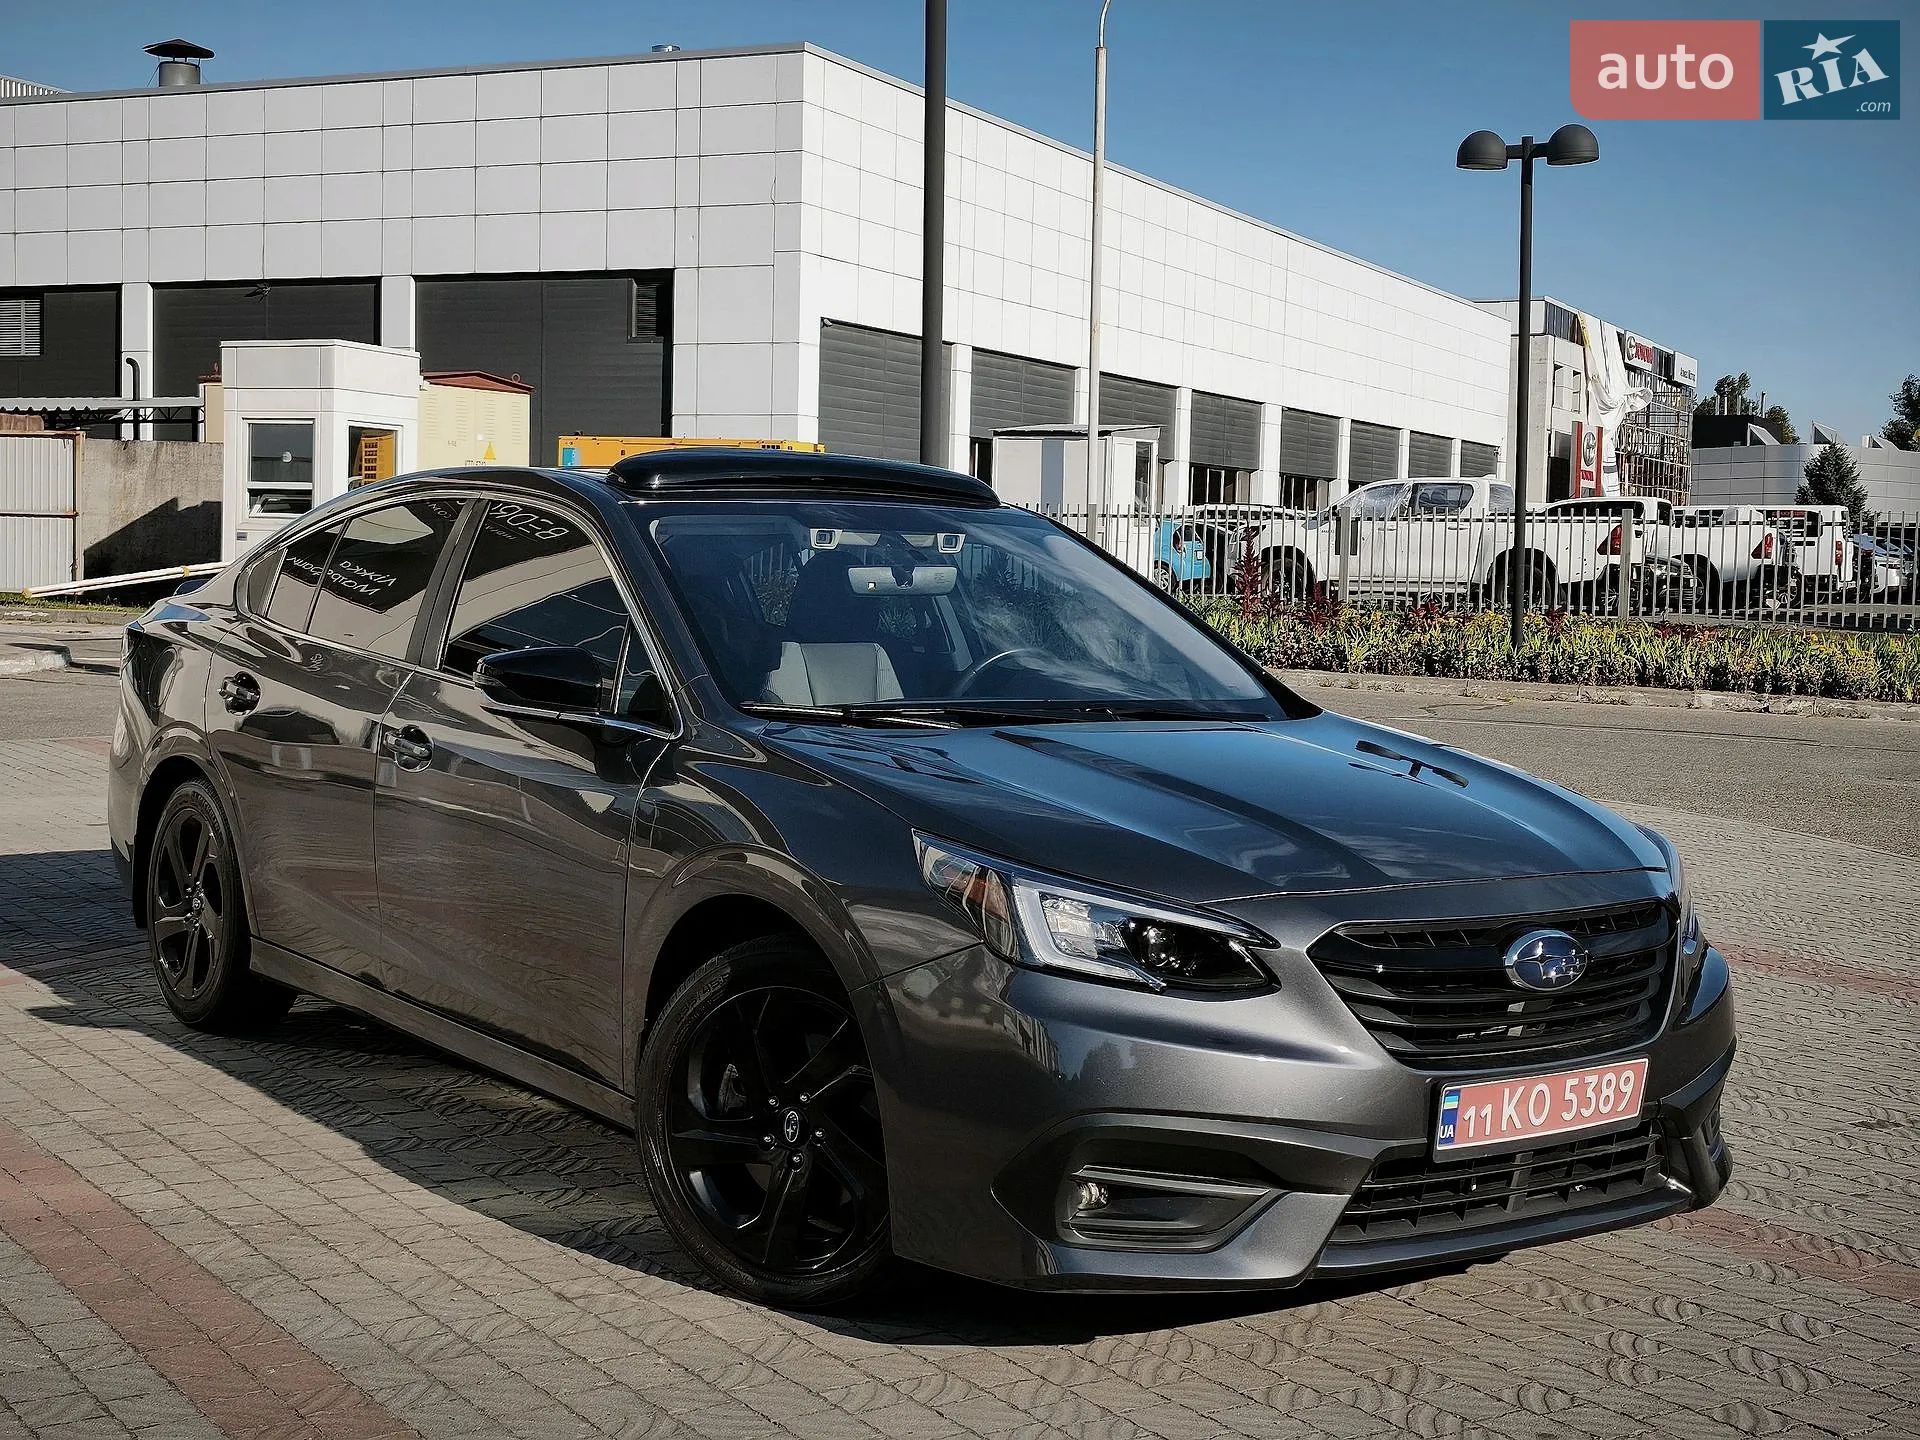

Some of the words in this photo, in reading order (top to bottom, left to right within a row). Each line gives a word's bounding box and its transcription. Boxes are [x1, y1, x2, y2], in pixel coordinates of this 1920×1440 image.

[1463, 1103, 1493, 1138] 11
[1500, 1083, 1551, 1132] KO
[1561, 1069, 1635, 1121] 5389
[1439, 1124, 1454, 1139] UA
